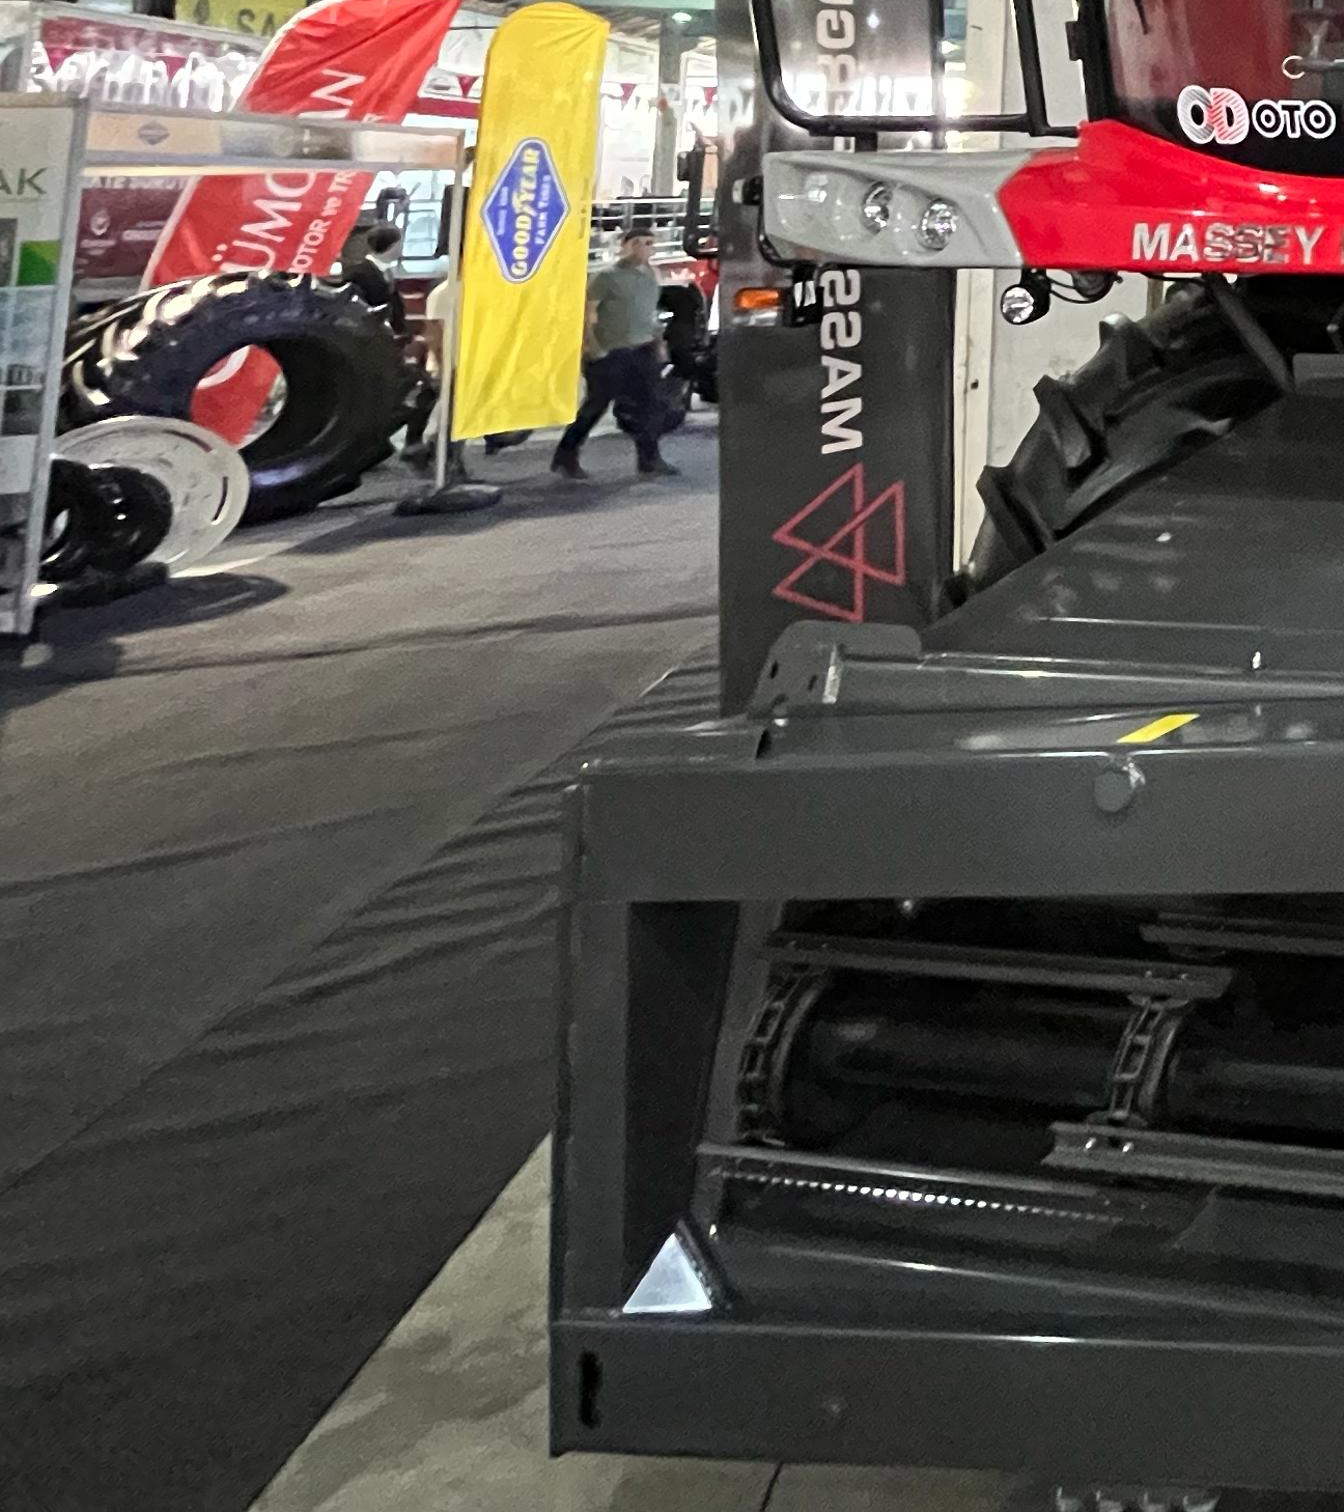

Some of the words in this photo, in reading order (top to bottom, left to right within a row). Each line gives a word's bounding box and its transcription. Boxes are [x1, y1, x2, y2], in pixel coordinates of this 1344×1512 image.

[236, 7, 275, 37] SA
[1252, 99, 1336, 139] OTO
[511, 148, 540, 276] GOODYEAR
[1132, 222, 1325, 265] MASSEY
